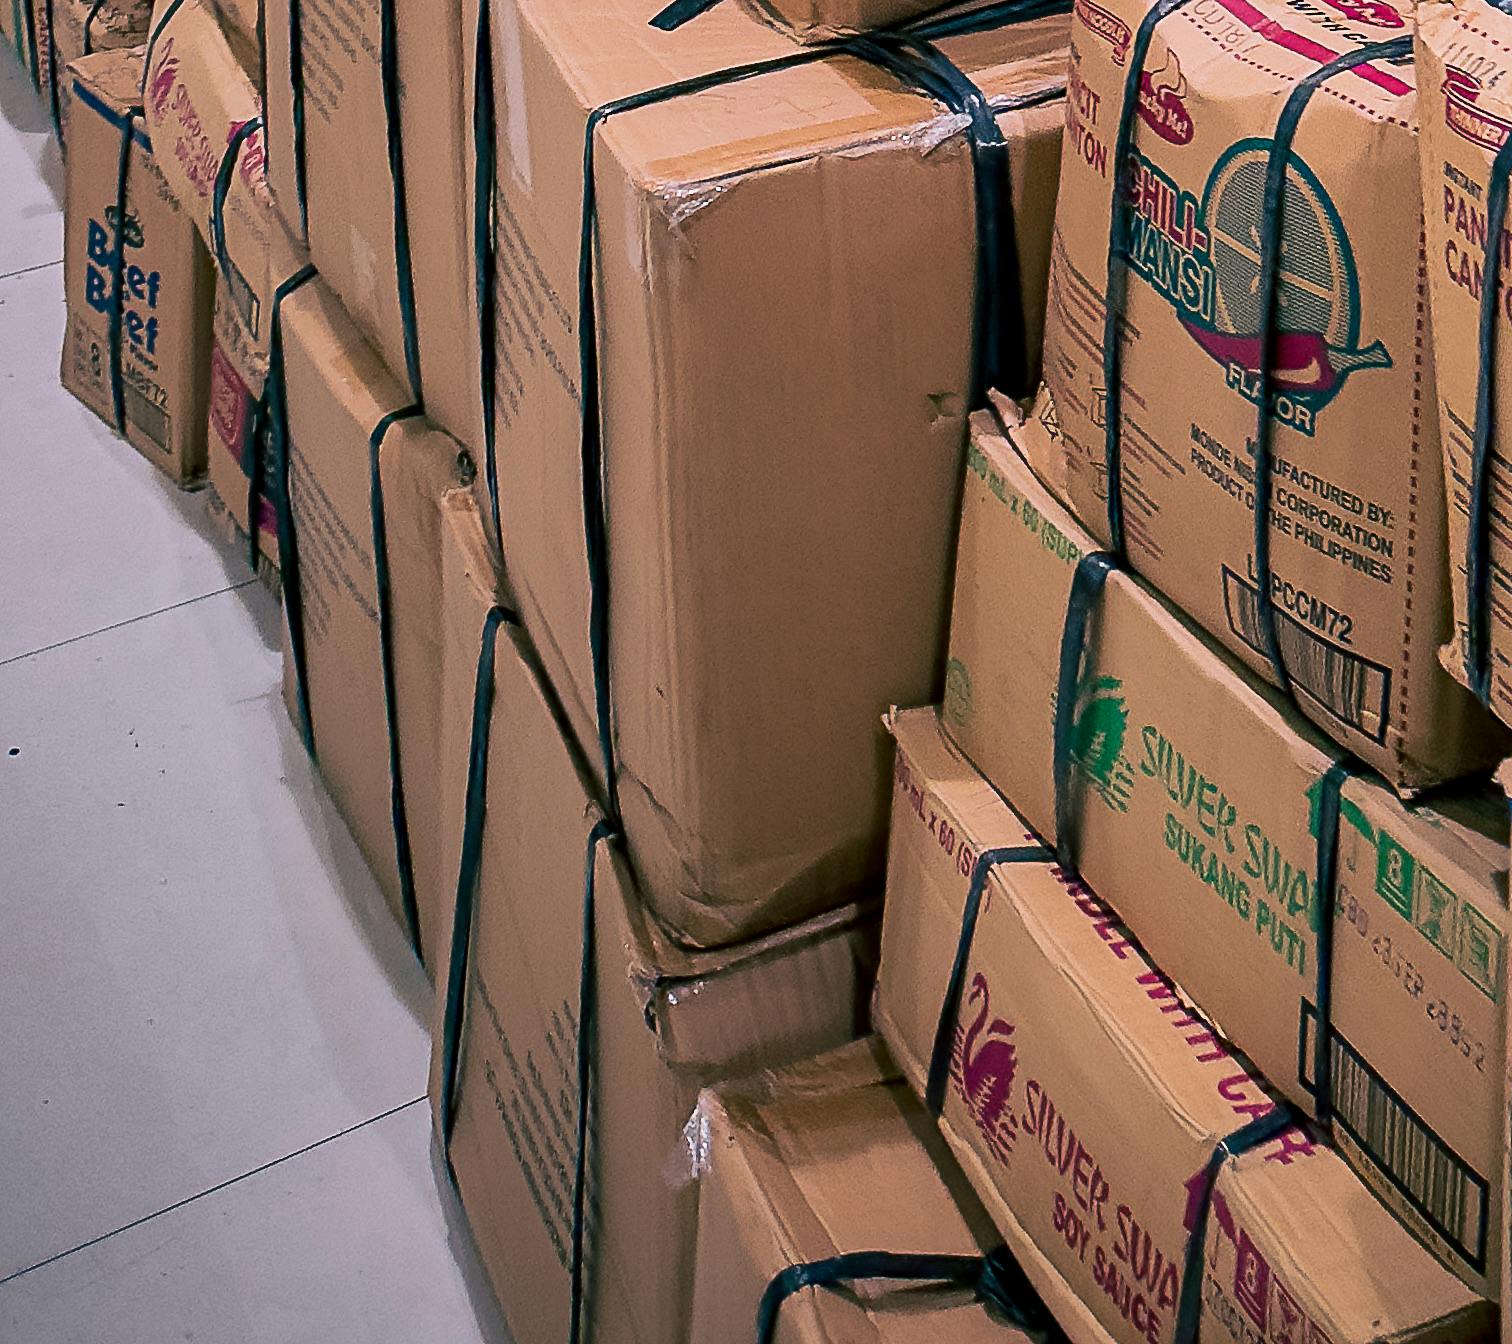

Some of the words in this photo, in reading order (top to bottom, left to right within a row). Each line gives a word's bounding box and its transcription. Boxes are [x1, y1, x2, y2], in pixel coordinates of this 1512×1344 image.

[1190, 447, 1244, 503] PRODUCT
[1294, 522, 1393, 585] PHILIPPINES
[1275, 486, 1395, 559] CORPORATION
[1366, 501, 1395, 529] BY:
[1246, 552, 1354, 645] LPCCM72
[1139, 723, 1238, 855] SILVER
[1239, 820, 1318, 917] SWA
[1162, 812, 1250, 915] SUKANG
[1254, 902, 1306, 975] PUTI
[1020, 1079, 1109, 1230] SILVER
[1114, 1205, 1178, 1310] SWA
[1051, 1192, 1090, 1264] SOY
